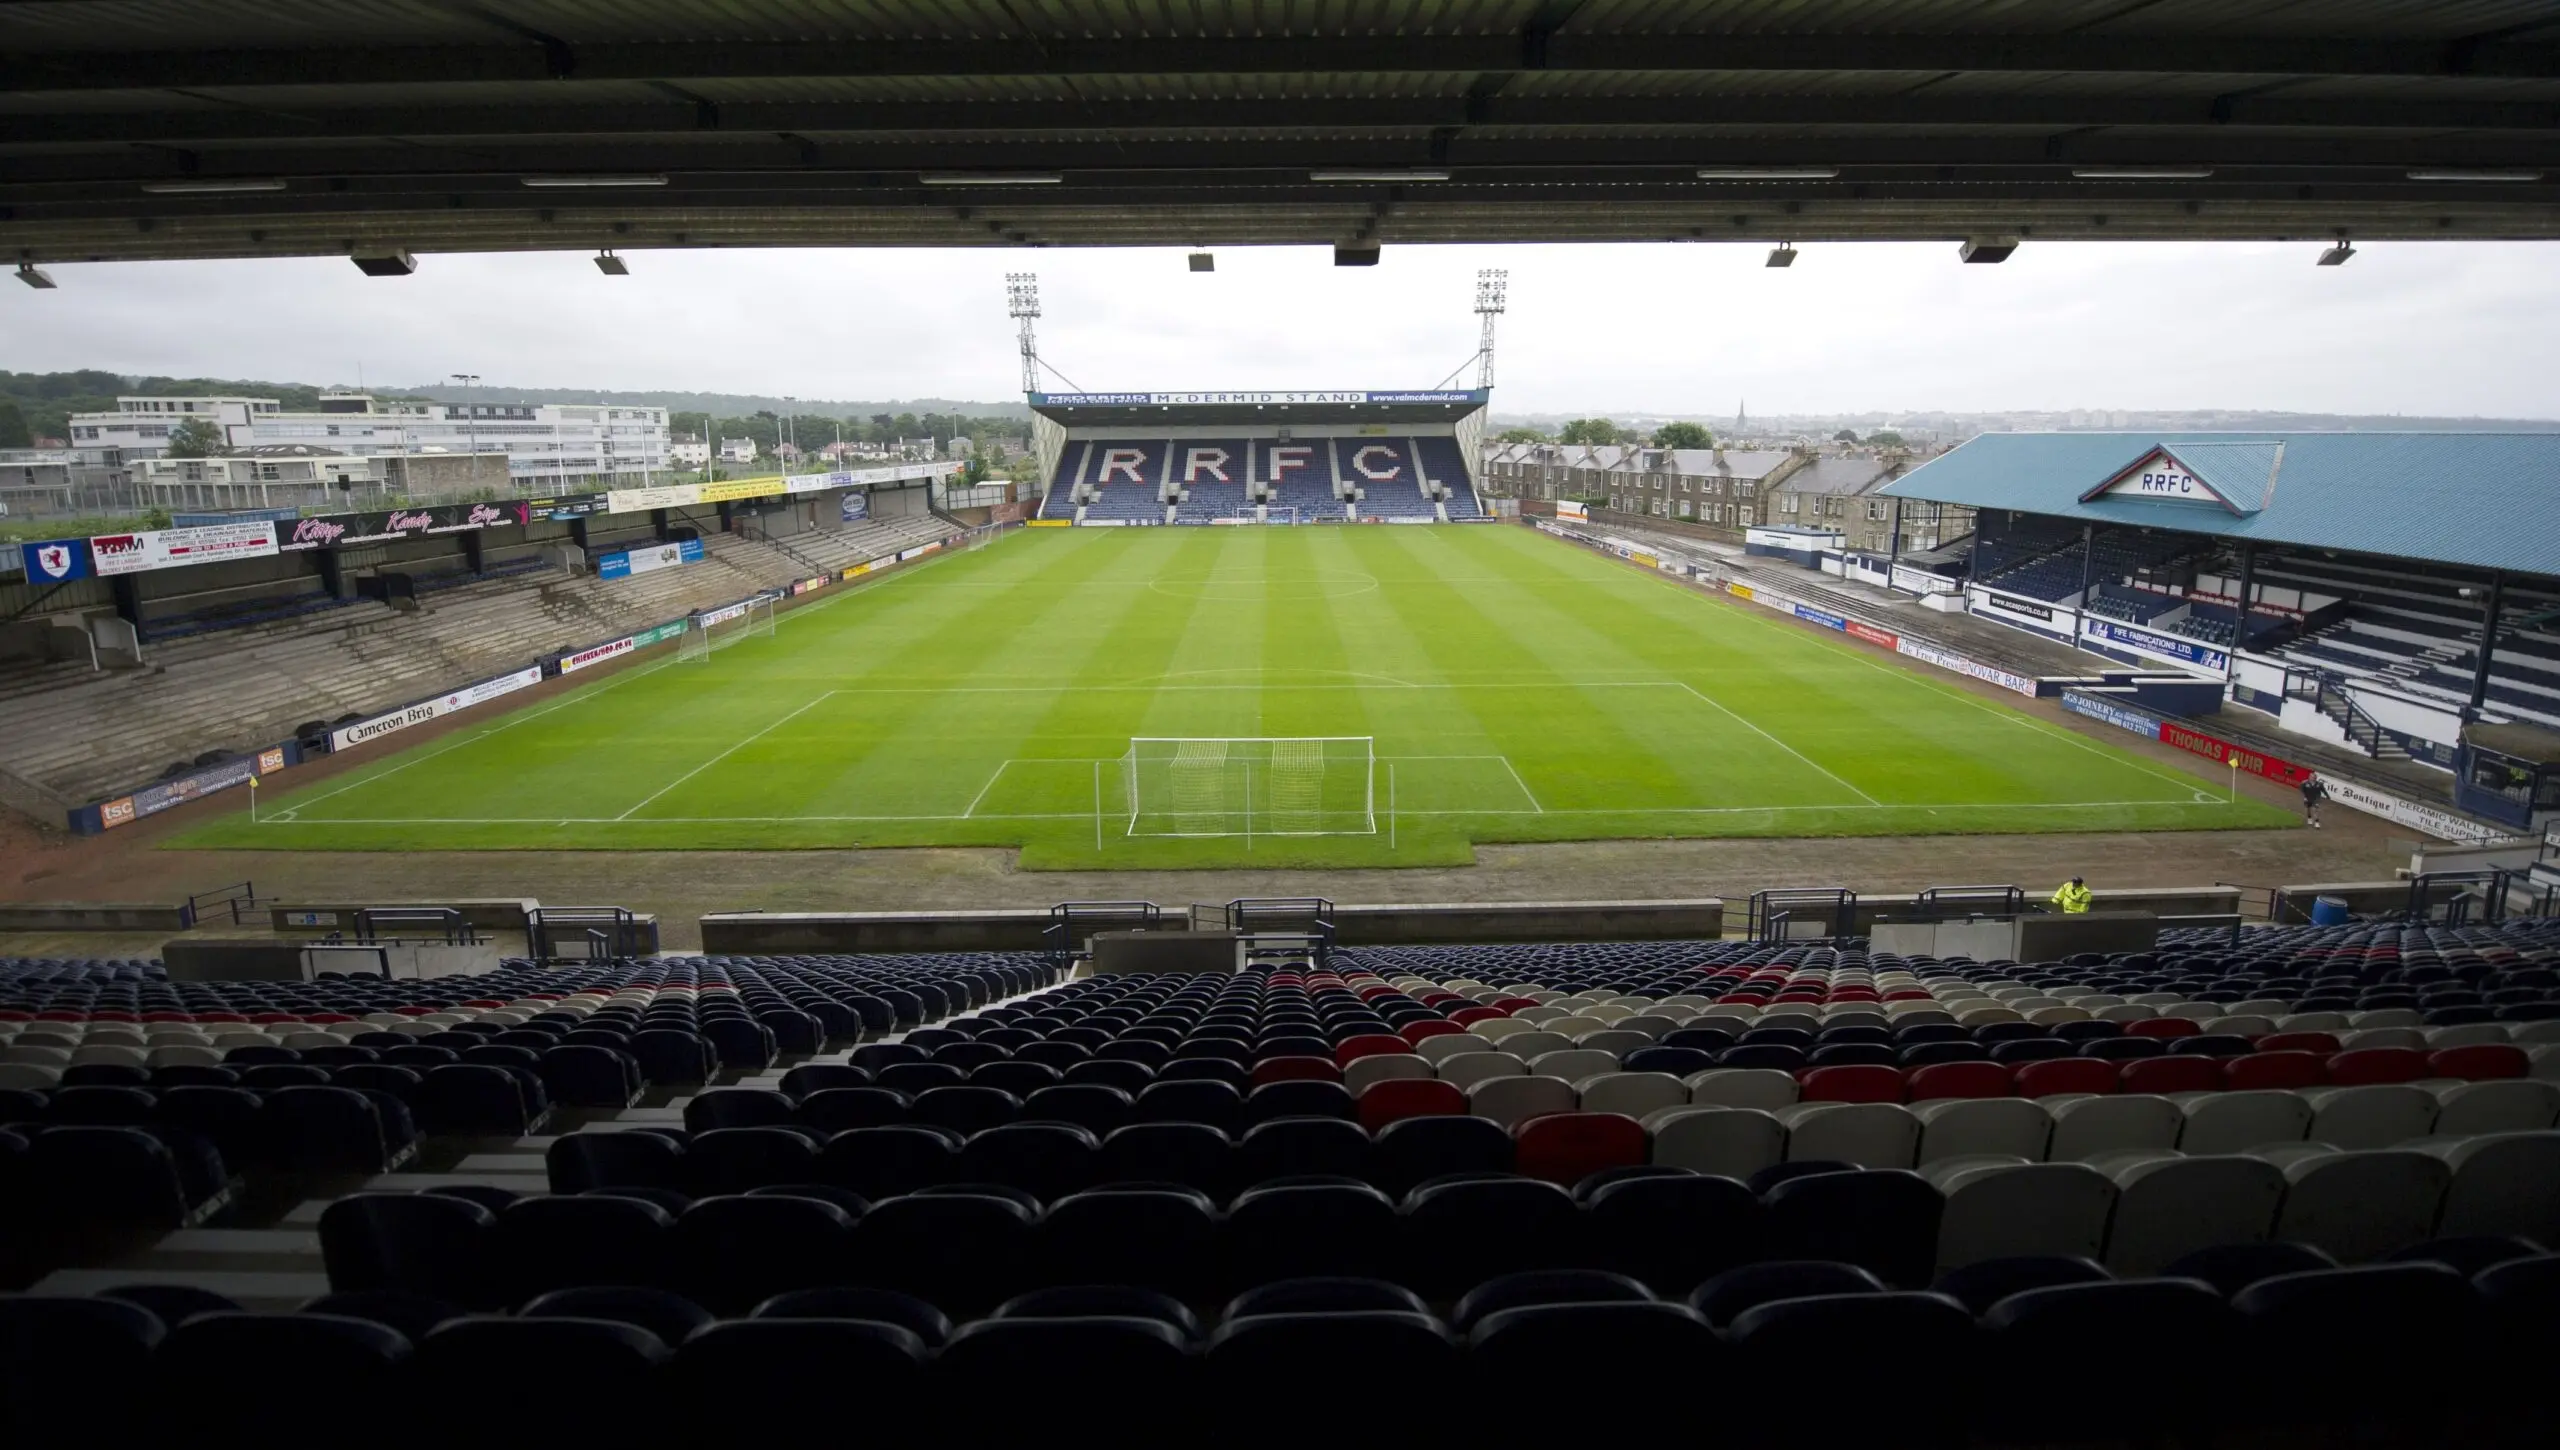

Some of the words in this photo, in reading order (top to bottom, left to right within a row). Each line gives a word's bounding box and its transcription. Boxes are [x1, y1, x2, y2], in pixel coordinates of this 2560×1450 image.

[1157, 394, 1272, 403] McDERMID
[1286, 393, 1361, 402] STAND
[1372, 393, 1468, 402] www.valmcdermid.com
[2142, 473, 2192, 494] RRFC
[158, 534, 190, 543] BUILDING
[203, 530, 237, 538] DRAINAGE
[239, 526, 272, 534] MATERIALS
[2113, 627, 2128, 638] FIFE
[2128, 631, 2177, 651] FABRICATIONS
[2177, 645, 2193, 656] LTD.
[1936, 652, 1959, 670] Press
[1967, 661, 2000, 683] NOVAR
[2004, 674, 2026, 692] BAR
[2075, 705, 2107, 723] FREEPHONE
[2077, 694, 2116, 716] JOINERY
[346, 714, 403, 744] Cameron
[407, 705, 434, 723] Brig
[260, 751, 283, 769] tsc
[2168, 727, 2223, 759] THOMAS
[2227, 748, 2264, 774] MUIR
[2342, 787, 2391, 812] Boutique
[103, 801, 133, 821] tsc
[2398, 800, 2448, 822] CERAMIC
[2449, 814, 2479, 833] WALL
[2482, 827, 2491, 836] &
[2419, 815, 2441, 829] TILE
